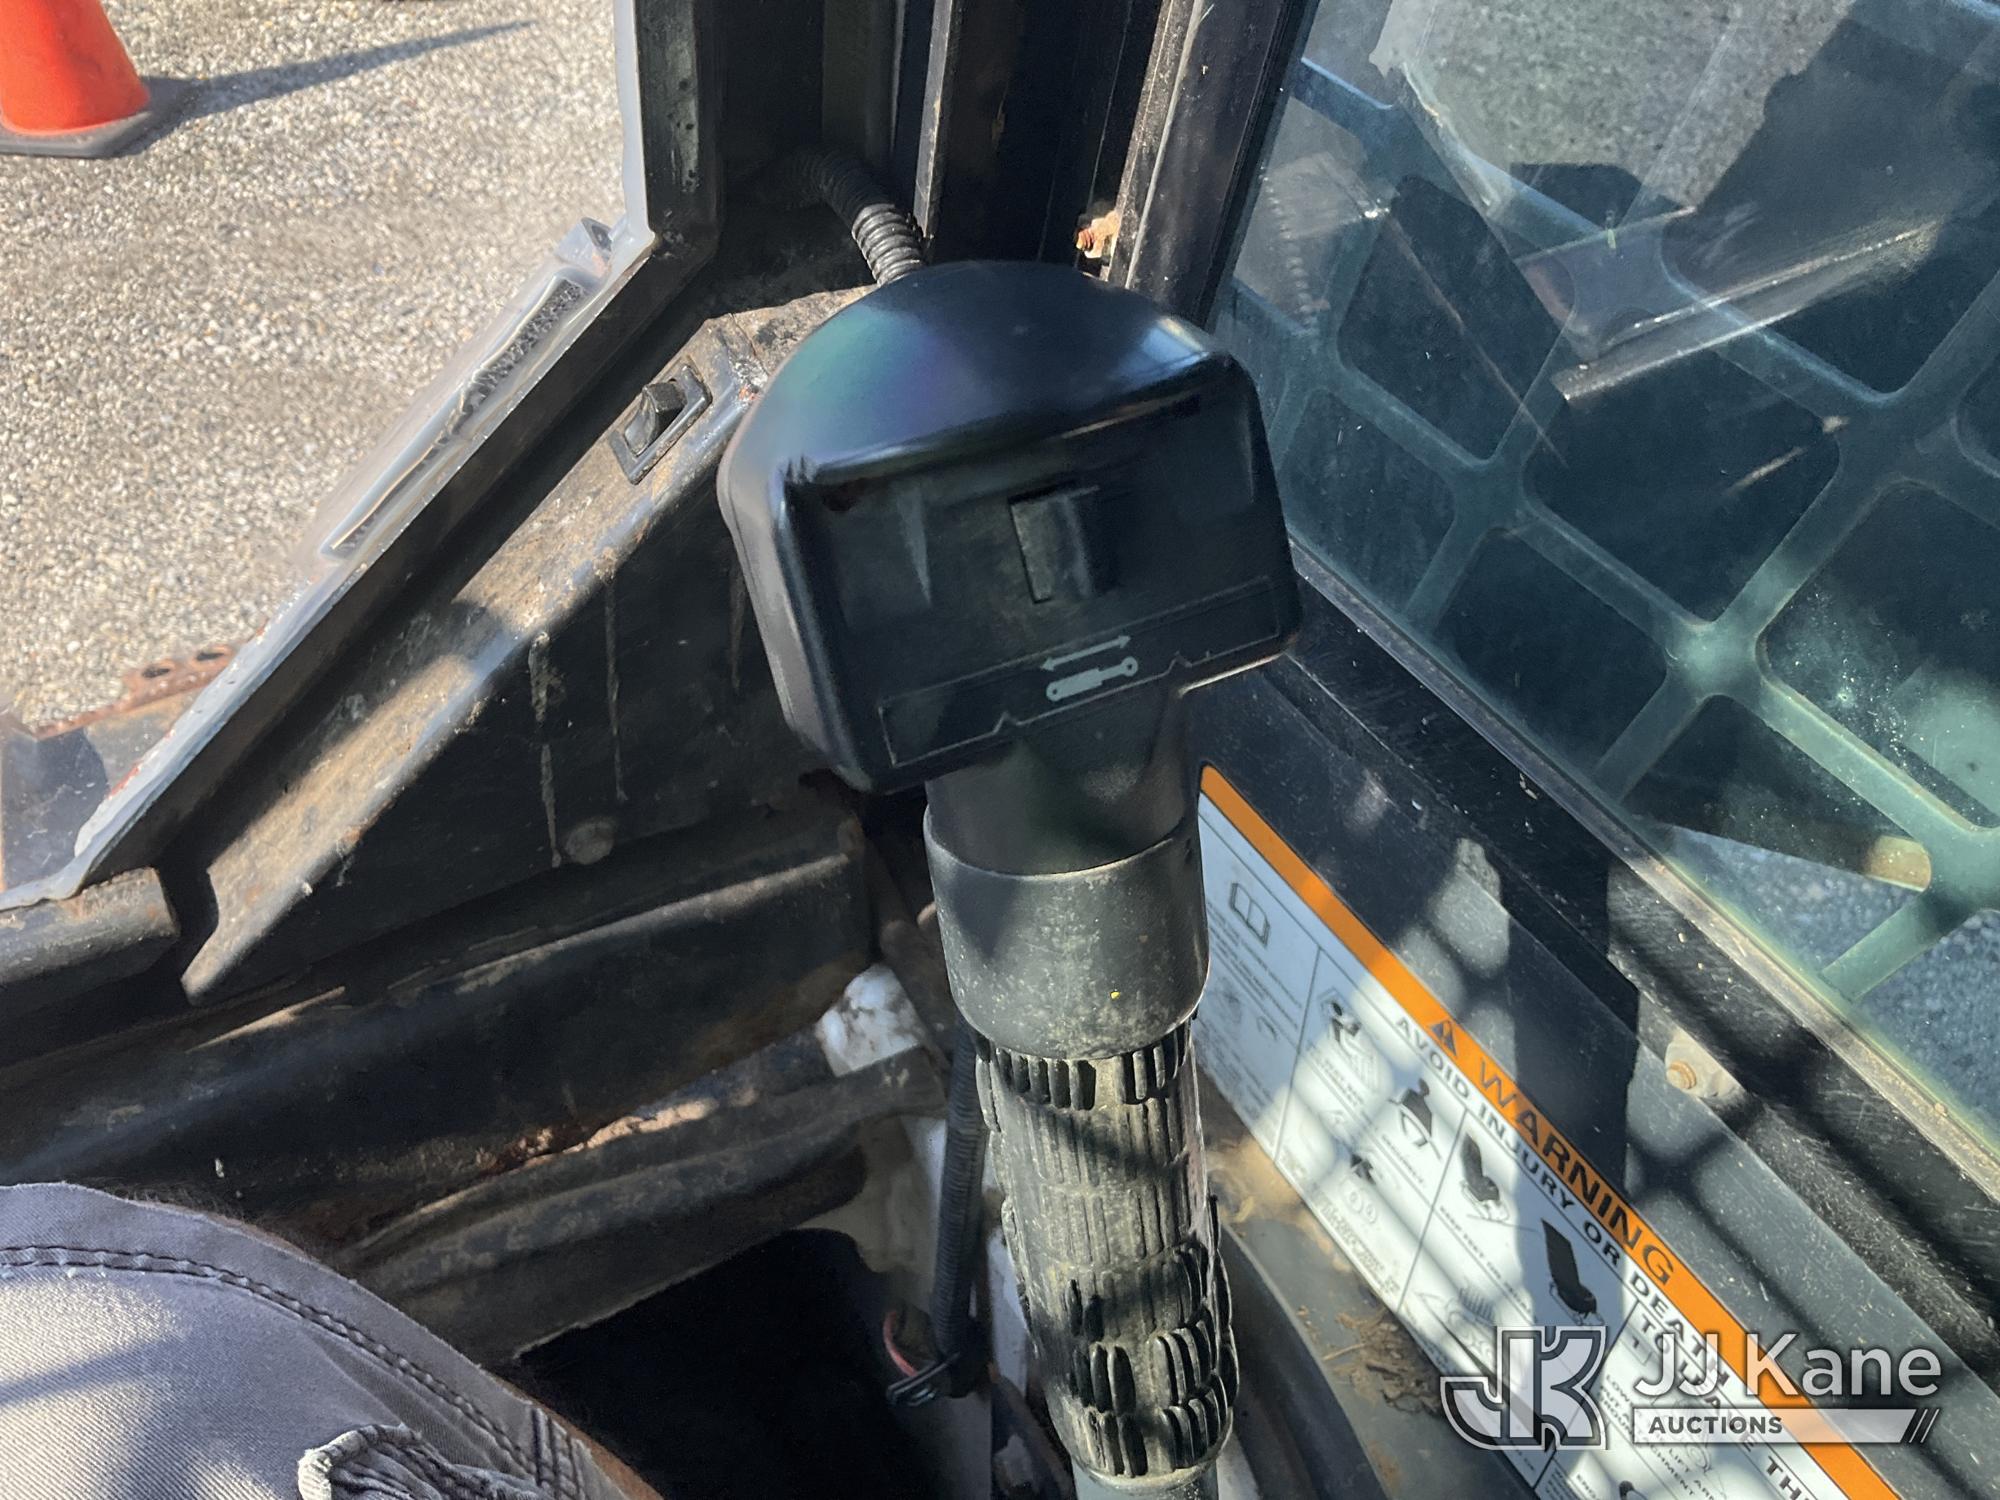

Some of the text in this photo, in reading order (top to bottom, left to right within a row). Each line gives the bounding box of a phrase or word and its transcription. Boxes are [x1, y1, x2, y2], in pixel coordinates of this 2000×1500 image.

[1396, 1016, 1470, 1099] AVOID
[1478, 1104, 1576, 1211] INJURY
[1583, 1220, 1622, 1267] OR
[1480, 1061, 1674, 1286] WARNING
[1677, 1360, 1758, 1453] LEAE
[1766, 1455, 1812, 1500] TH
